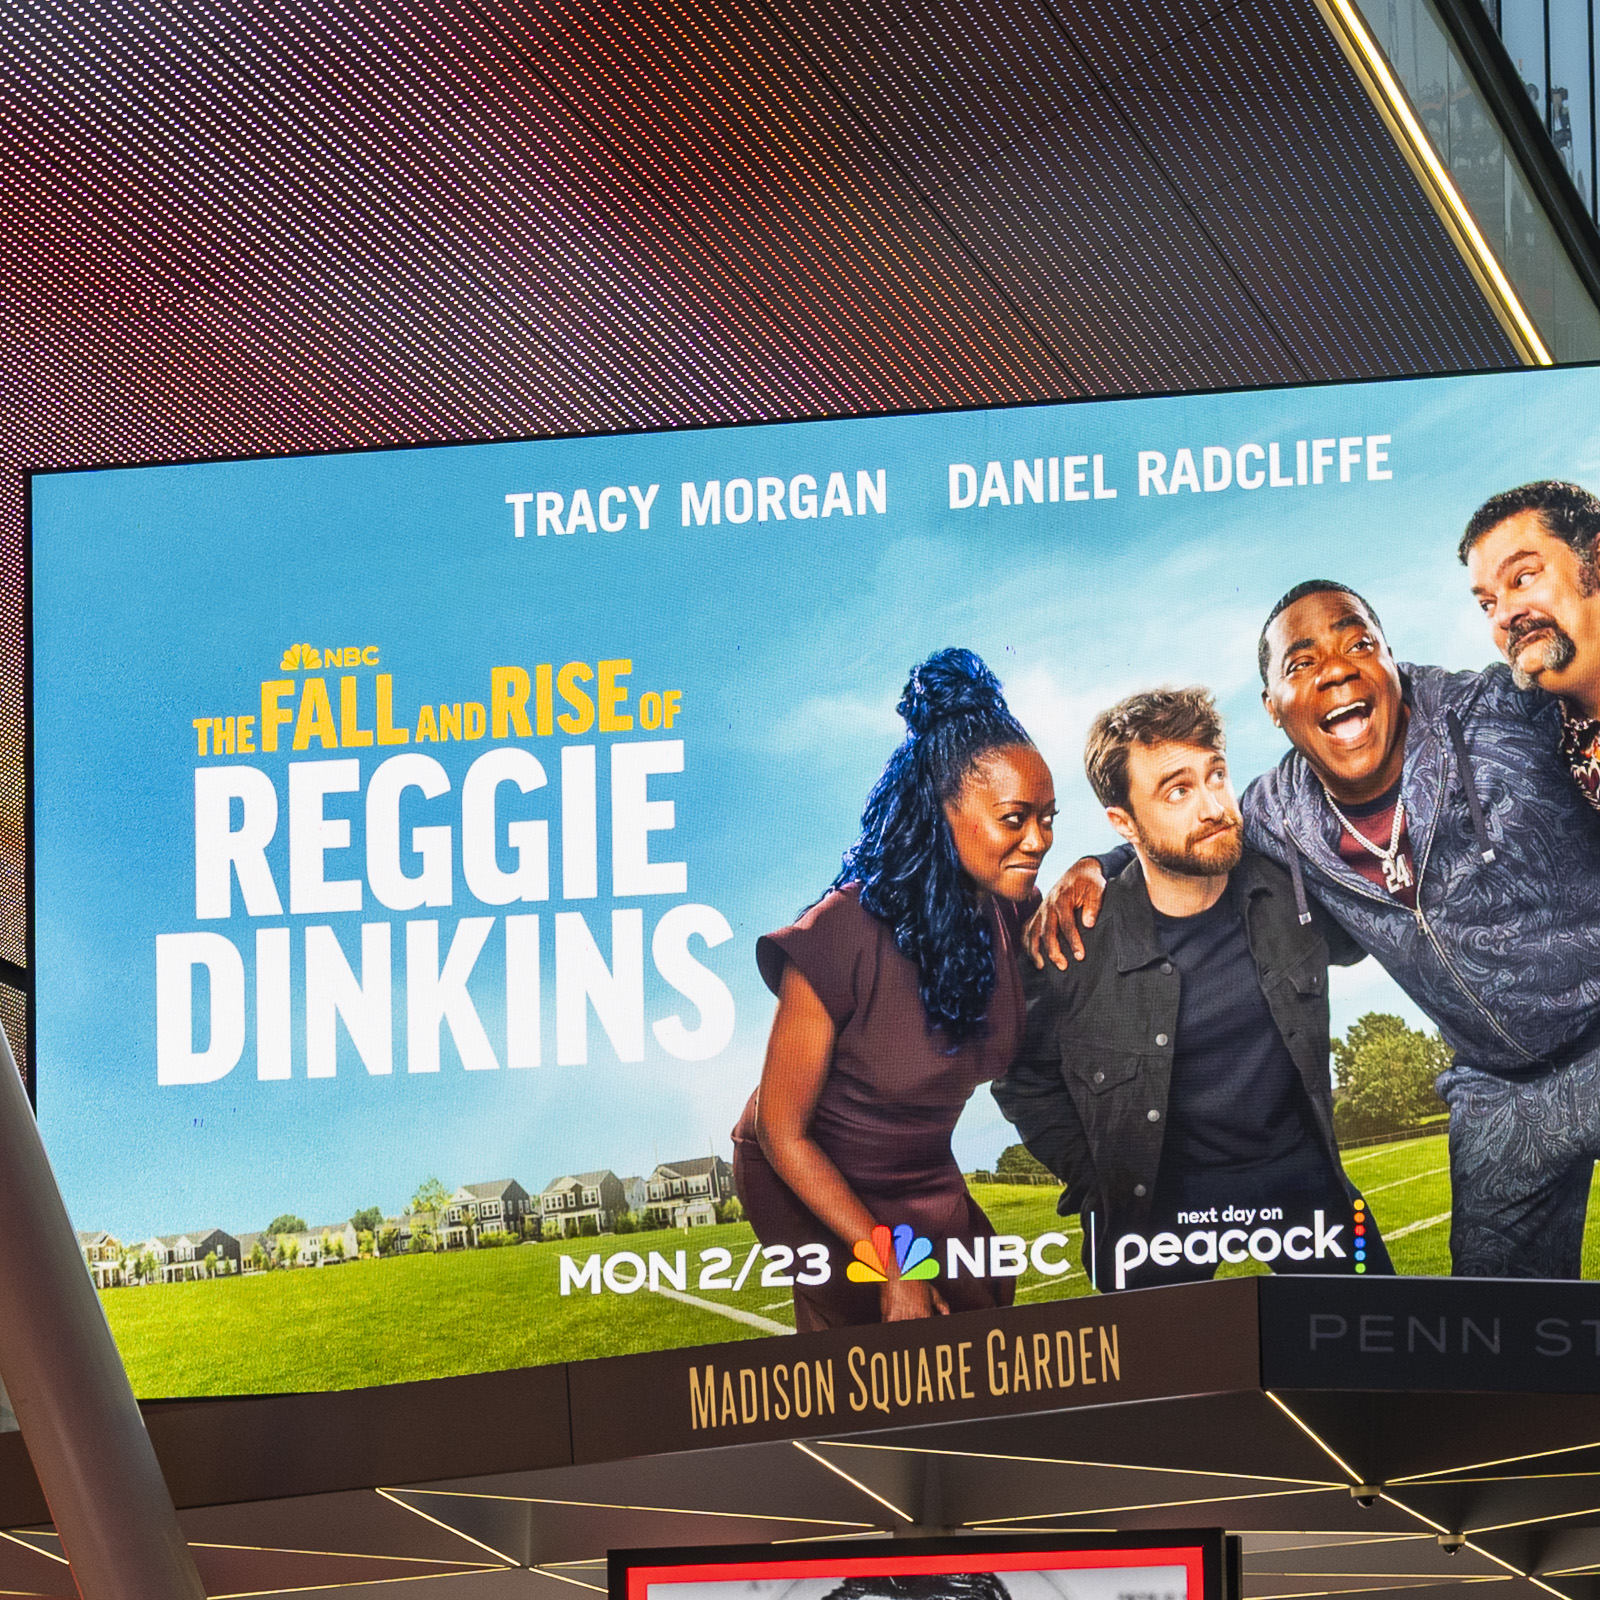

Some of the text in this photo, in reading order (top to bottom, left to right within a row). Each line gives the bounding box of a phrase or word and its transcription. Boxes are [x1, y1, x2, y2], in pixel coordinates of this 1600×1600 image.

[505, 468, 888, 538] TRACY MORGAN
[947, 434, 1393, 511] DANIEL RADCLIFFE
[323, 645, 380, 667] NBC
[192, 658, 683, 757] THE FALL AND RISE OF
[194, 740, 689, 919] REGGIE
[1381, 854, 1413, 894] 24
[155, 903, 737, 1086] DINKINS
[1114, 1210, 1347, 1290] peacock
[1177, 1205, 1283, 1227] next day on
[559, 1243, 832, 1297] MON 2/23
[946, 1232, 1071, 1280] NBC
[1310, 1313, 1502, 1354] PENN
[688, 1324, 1121, 1430] MADISON SQUARE GARDEN
